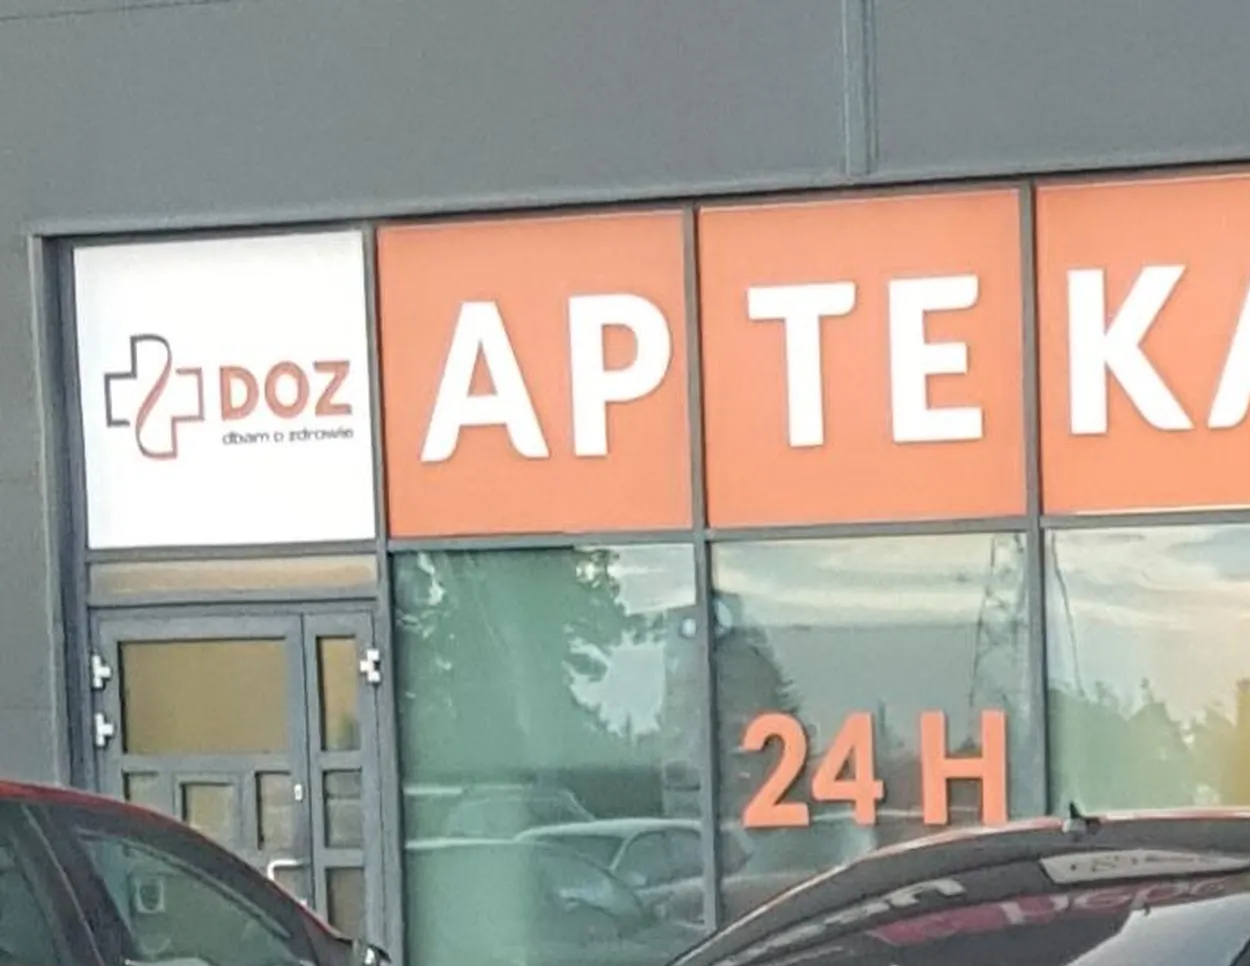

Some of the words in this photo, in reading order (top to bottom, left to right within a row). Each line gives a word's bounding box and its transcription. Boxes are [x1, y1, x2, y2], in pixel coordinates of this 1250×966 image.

[219, 360, 353, 421] DOZ
[222, 430, 270, 445] dbam
[741, 710, 884, 828] 24
[921, 709, 1008, 826] H
